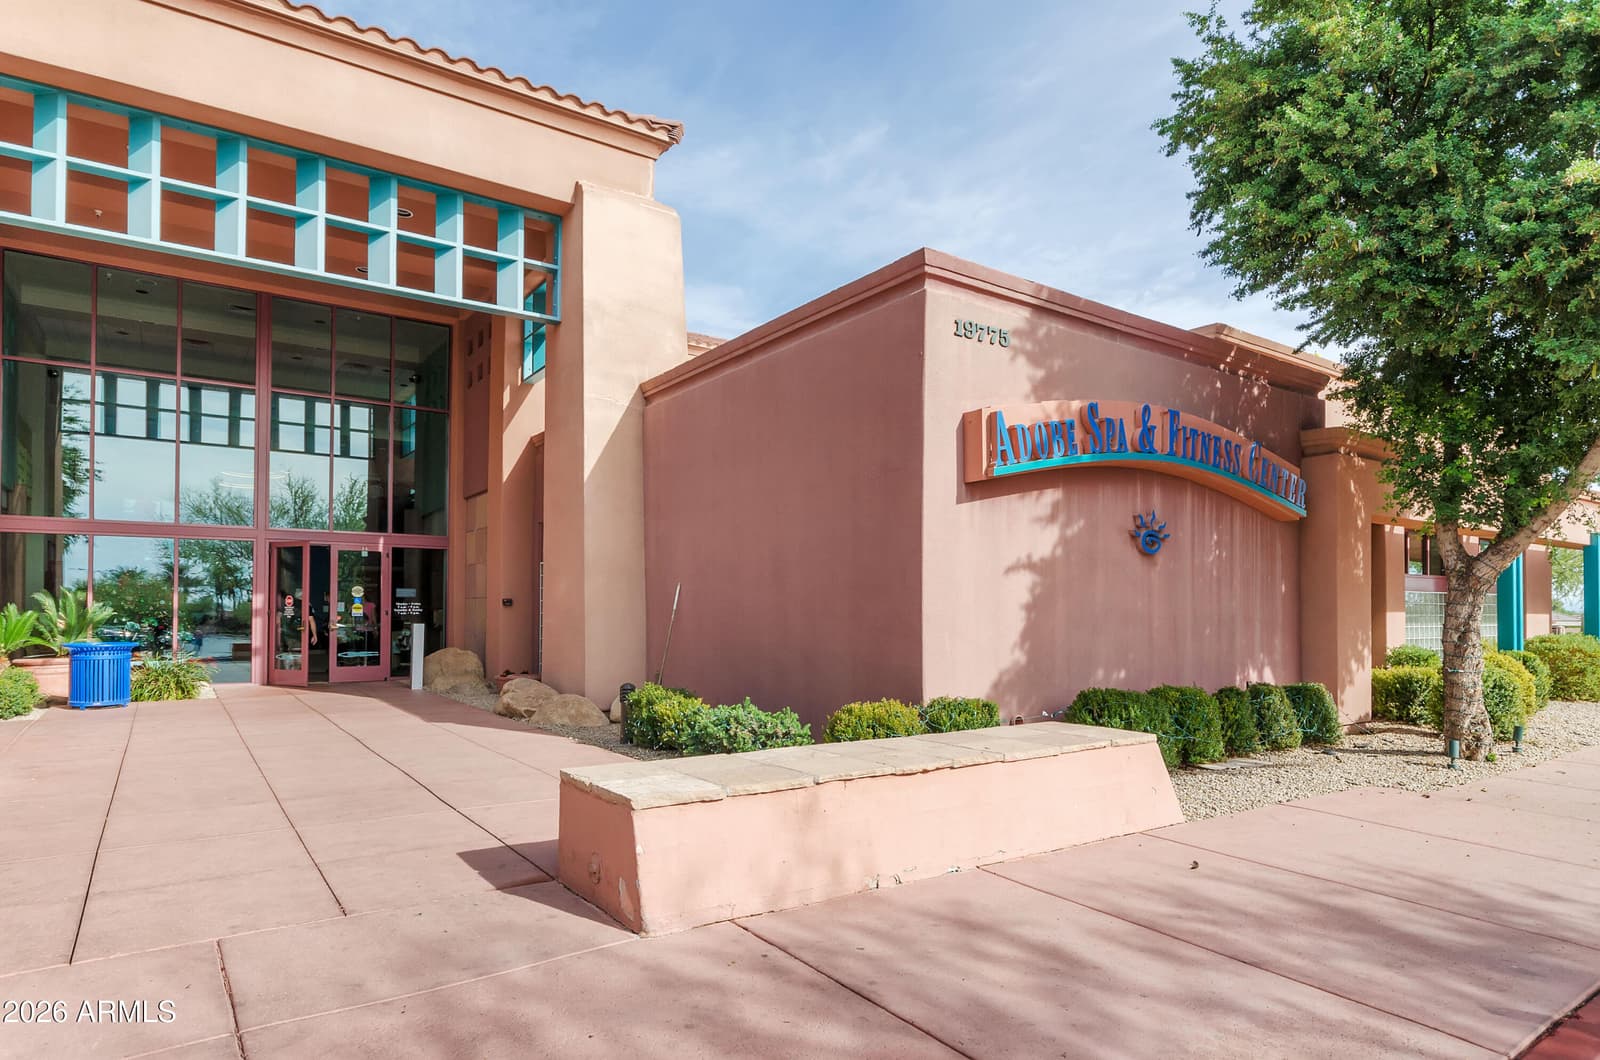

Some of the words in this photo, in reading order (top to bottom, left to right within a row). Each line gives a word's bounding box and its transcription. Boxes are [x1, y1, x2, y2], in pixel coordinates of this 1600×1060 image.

[953, 319, 1009, 348] 19775
[995, 410, 1078, 466] ADOBE
[1087, 402, 1129, 453] SPA
[1138, 403, 1158, 454] &
[1166, 408, 1242, 475] FITNESS
[1248, 440, 1307, 509] CENTER
